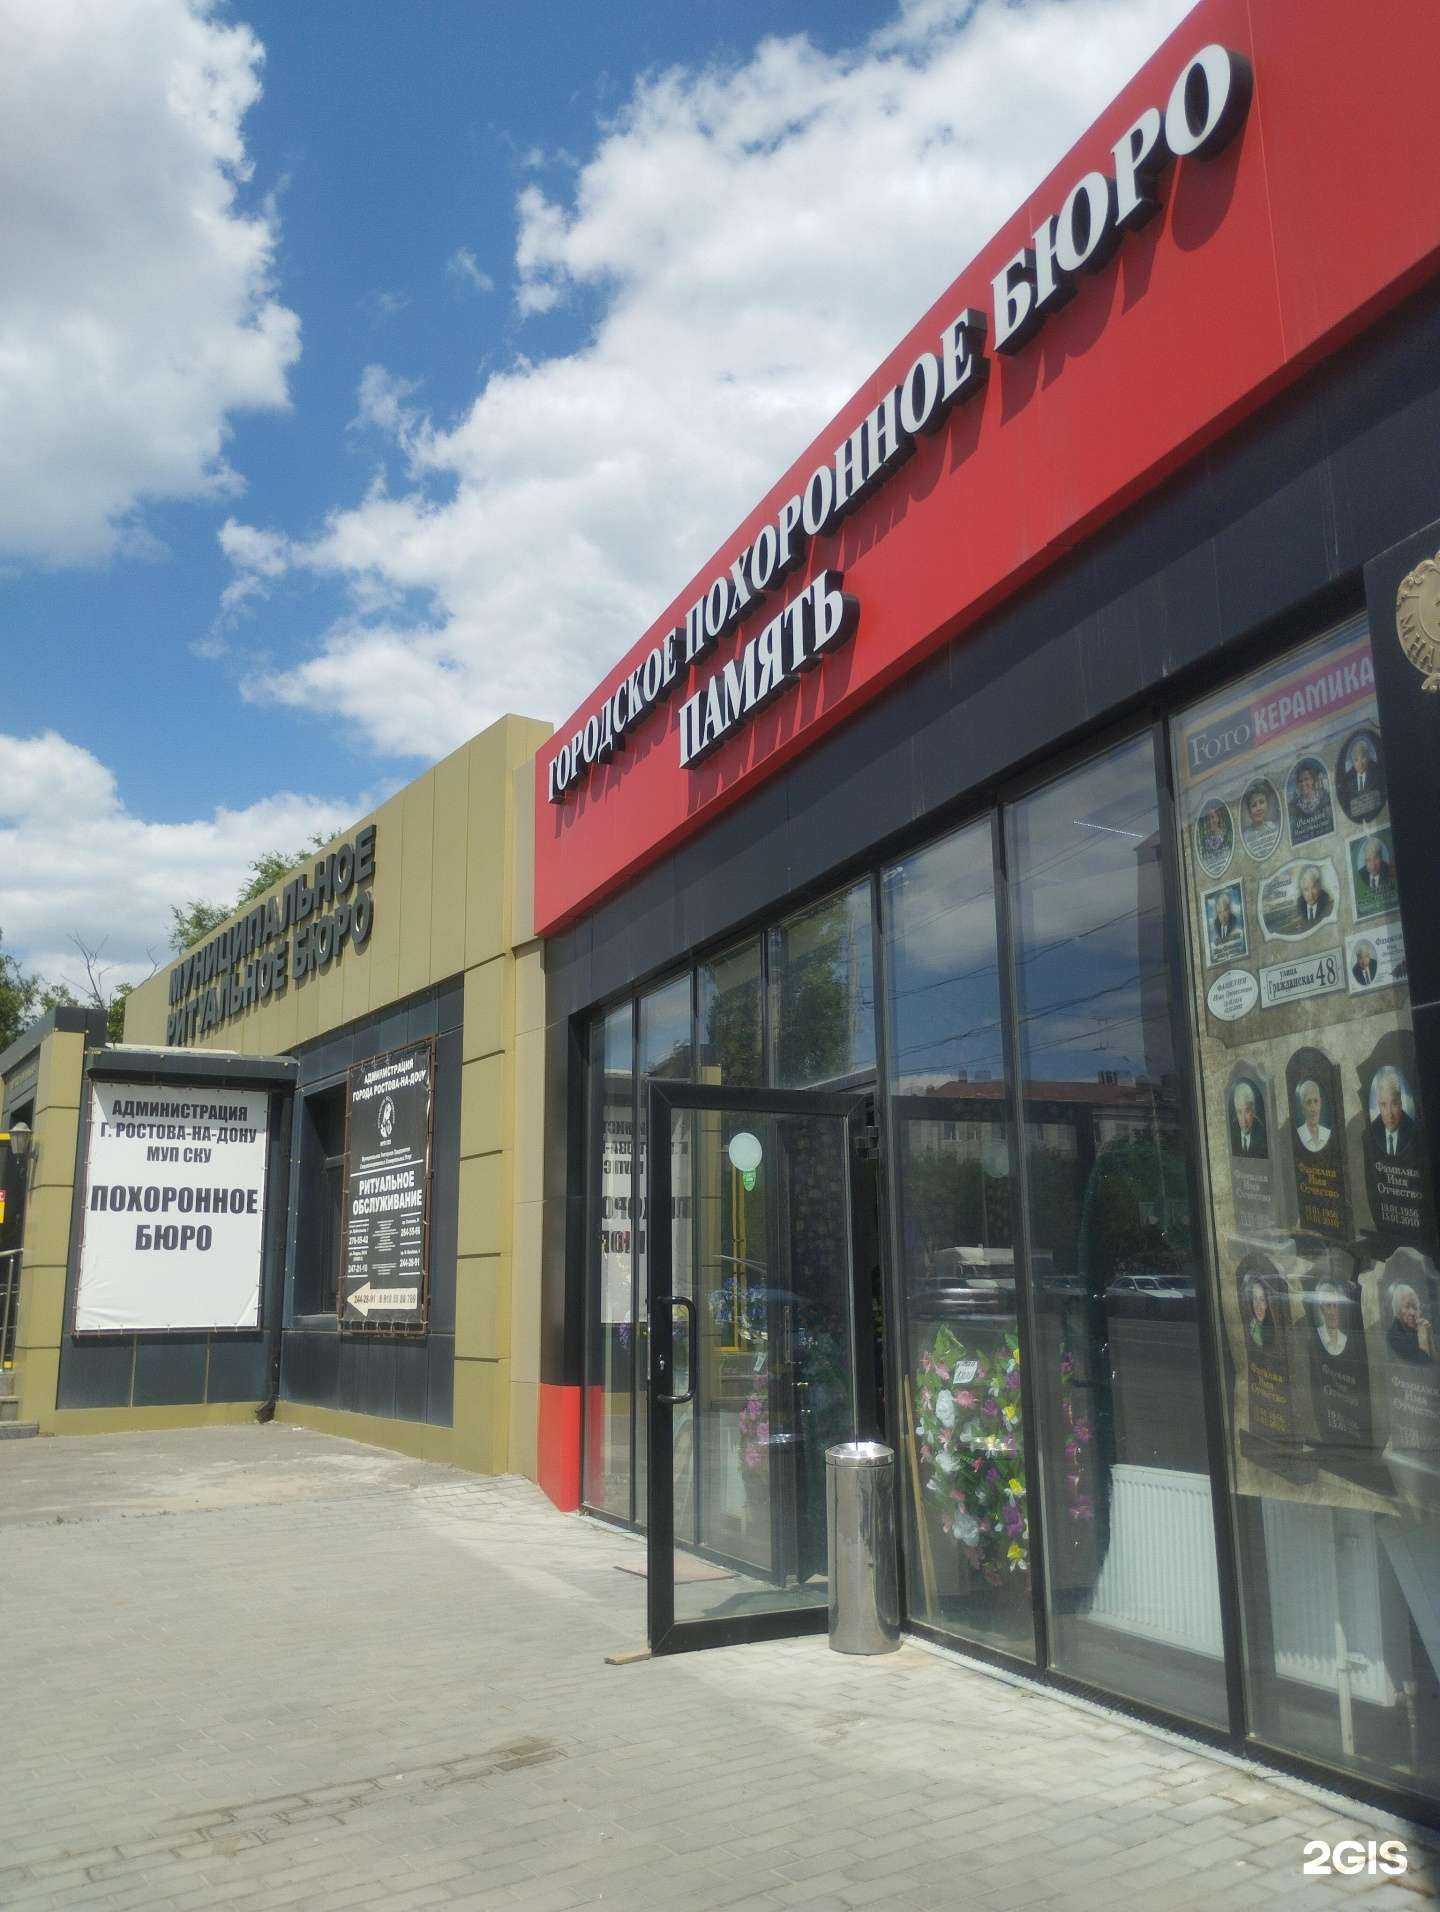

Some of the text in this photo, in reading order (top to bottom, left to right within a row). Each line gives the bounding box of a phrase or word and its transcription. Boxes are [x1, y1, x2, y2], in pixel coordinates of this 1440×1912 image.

[548, 43, 1240, 804] ГОРОДСКОЕ ПОХОРОННОЕ БЮРО
[679, 569, 850, 769] ПАМЯТЬ
[1253, 656, 1375, 738] КЕРАМИКА
[169, 824, 377, 1006] МУНИЦИПАЛЬНОЕ
[167, 889, 374, 1046] РИТУАЛЬНОЕ БЮРО
[1268, 974, 1315, 997] Гражданская
[1316, 957, 1337, 986] 48
[364, 1058, 414, 1084] АДМИНИСТРАЦИЯ
[352, 1087, 373, 1102] ГОРОДА
[112, 1100, 248, 1122] АДМИНИСТРАЦИЯ
[100, 1123, 257, 1144] Г. РОСТОВА-НА-ДОНУ
[147, 1146, 212, 1163] МУП СКУ
[359, 1170, 415, 1196] РИТУАЛЬНОЕ
[90, 1185, 258, 1214] ПОХОРОННОЕ
[352, 1189, 423, 1216] ОБСЛУЖИВАНИЕ
[135, 1224, 213, 1251] БЮРО
